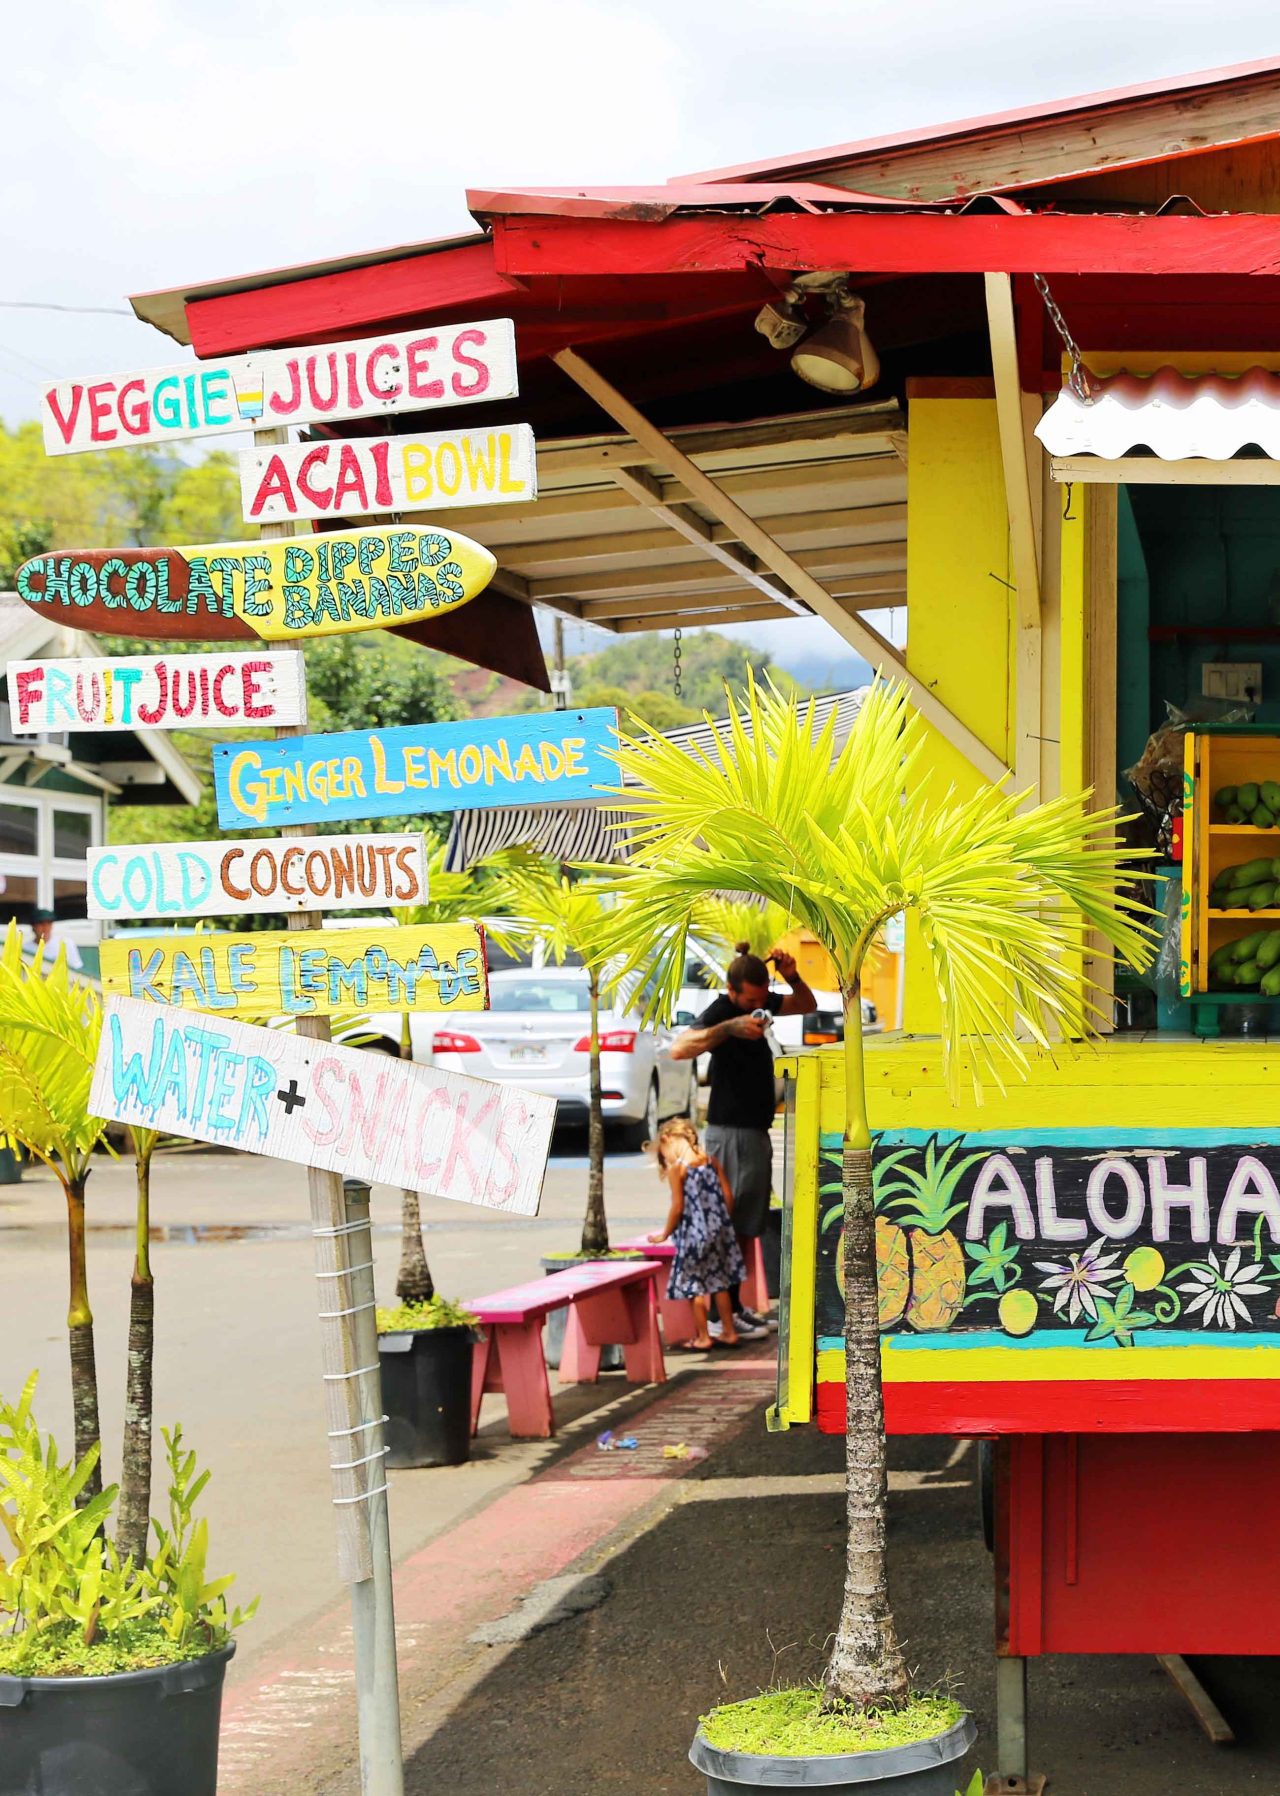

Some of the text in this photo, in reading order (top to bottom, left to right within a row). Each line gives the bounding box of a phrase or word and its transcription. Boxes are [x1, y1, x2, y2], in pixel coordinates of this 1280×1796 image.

[45, 329, 489, 444] VEGGIE JUICES
[250, 434, 526, 516] ACAI BOWL
[16, 532, 453, 618] CHOCOLATE DIPPED
[283, 562, 465, 629] BANANAS
[17, 661, 276, 726] FRUIT JUICE
[229, 735, 590, 823] GINGER LEMONADE
[92, 845, 420, 913] COLD COCONUTS
[128, 943, 482, 1015] KALE LEMONADE
[110, 1014, 277, 1143] WATER
[302, 1056, 528, 1205] SNACKS
